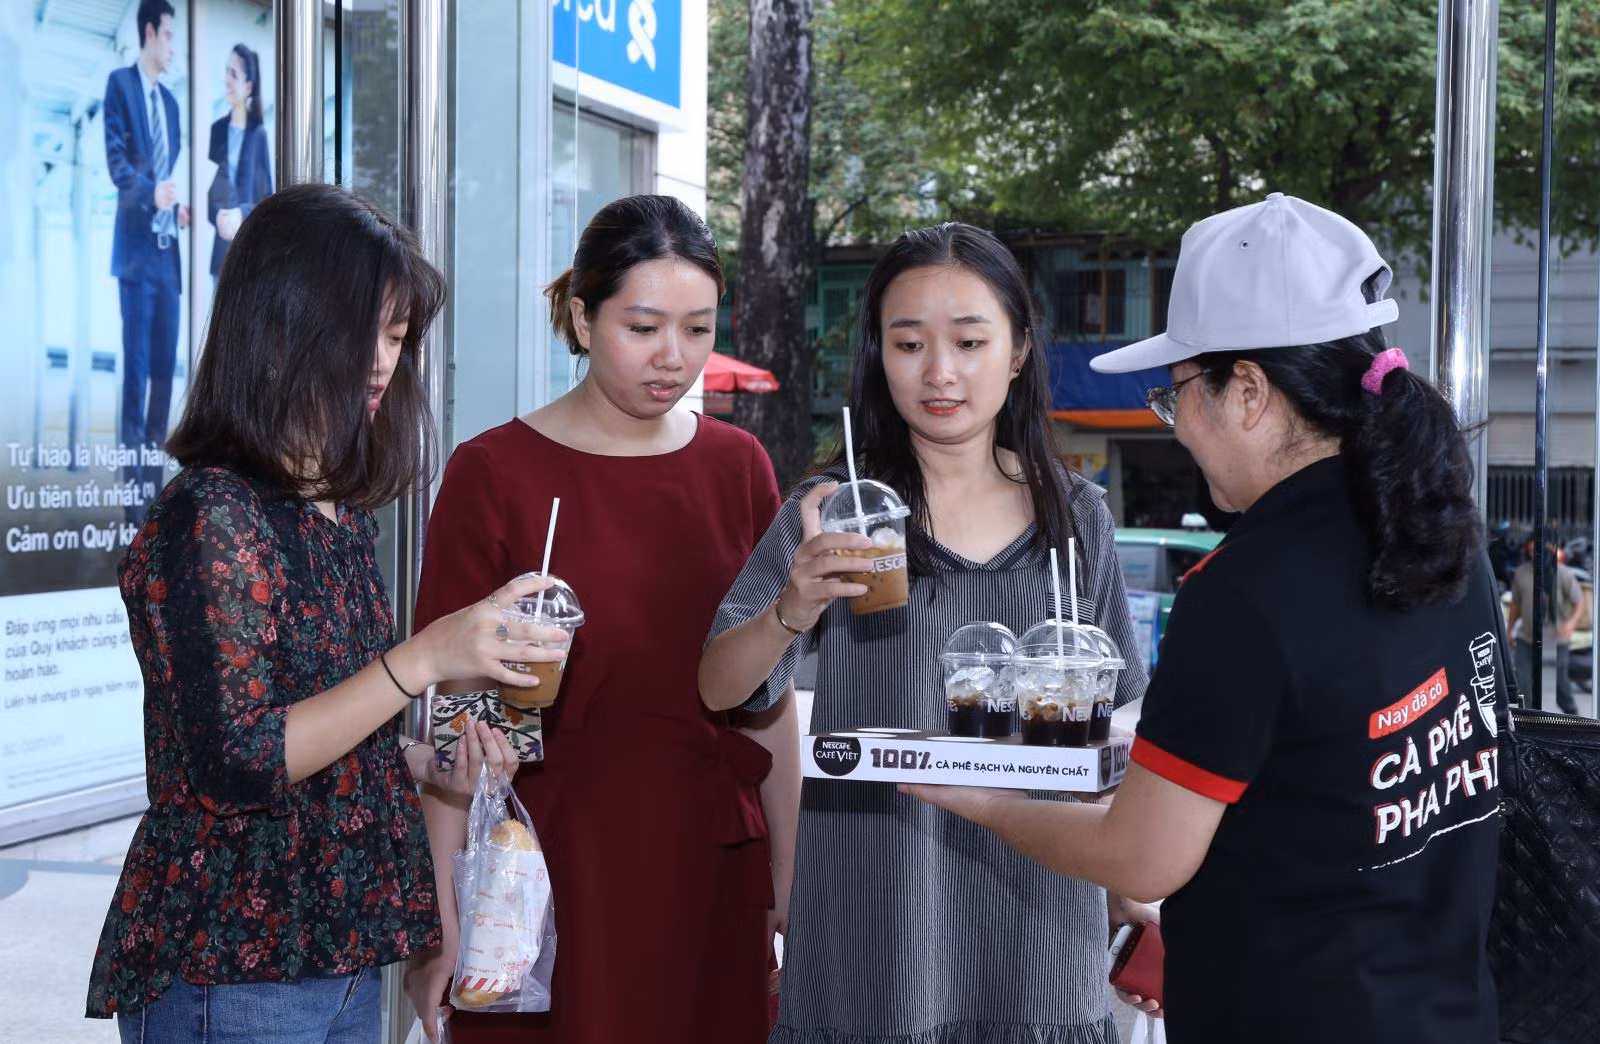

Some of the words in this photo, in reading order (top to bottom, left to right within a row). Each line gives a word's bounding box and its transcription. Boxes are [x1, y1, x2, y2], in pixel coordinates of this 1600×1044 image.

[7, 442, 34, 472] Tự
[38, 442, 71, 467] hào
[75, 441, 90, 467] là
[95, 442, 137, 472] Ngân
[7, 485, 35, 510] Ưu
[76, 479, 100, 508] tốt
[6, 524, 49, 553] Cảm
[53, 529, 79, 550] ơn
[82, 522, 117, 552] Quý
[82, 613, 102, 627] nhu
[1378, 704, 1409, 729] Nay
[1411, 689, 1428, 712] đã
[1429, 678, 1443, 700] có
[816, 750, 836, 759] CAFÉ
[1371, 736, 1421, 790] CÀ
[1427, 693, 1473, 767] PHÊ
[870, 748, 932, 770] 100%
[935, 759, 950, 770] CÀ
[952, 760, 972, 771] PHÊ
[973, 762, 1001, 773] SẠCH
[1002, 763, 1016, 773] VÀ
[1018, 764, 1060, 776] NGUYÊN
[1061, 765, 1089, 777] CHẤT
[1375, 782, 1440, 844] PHA
